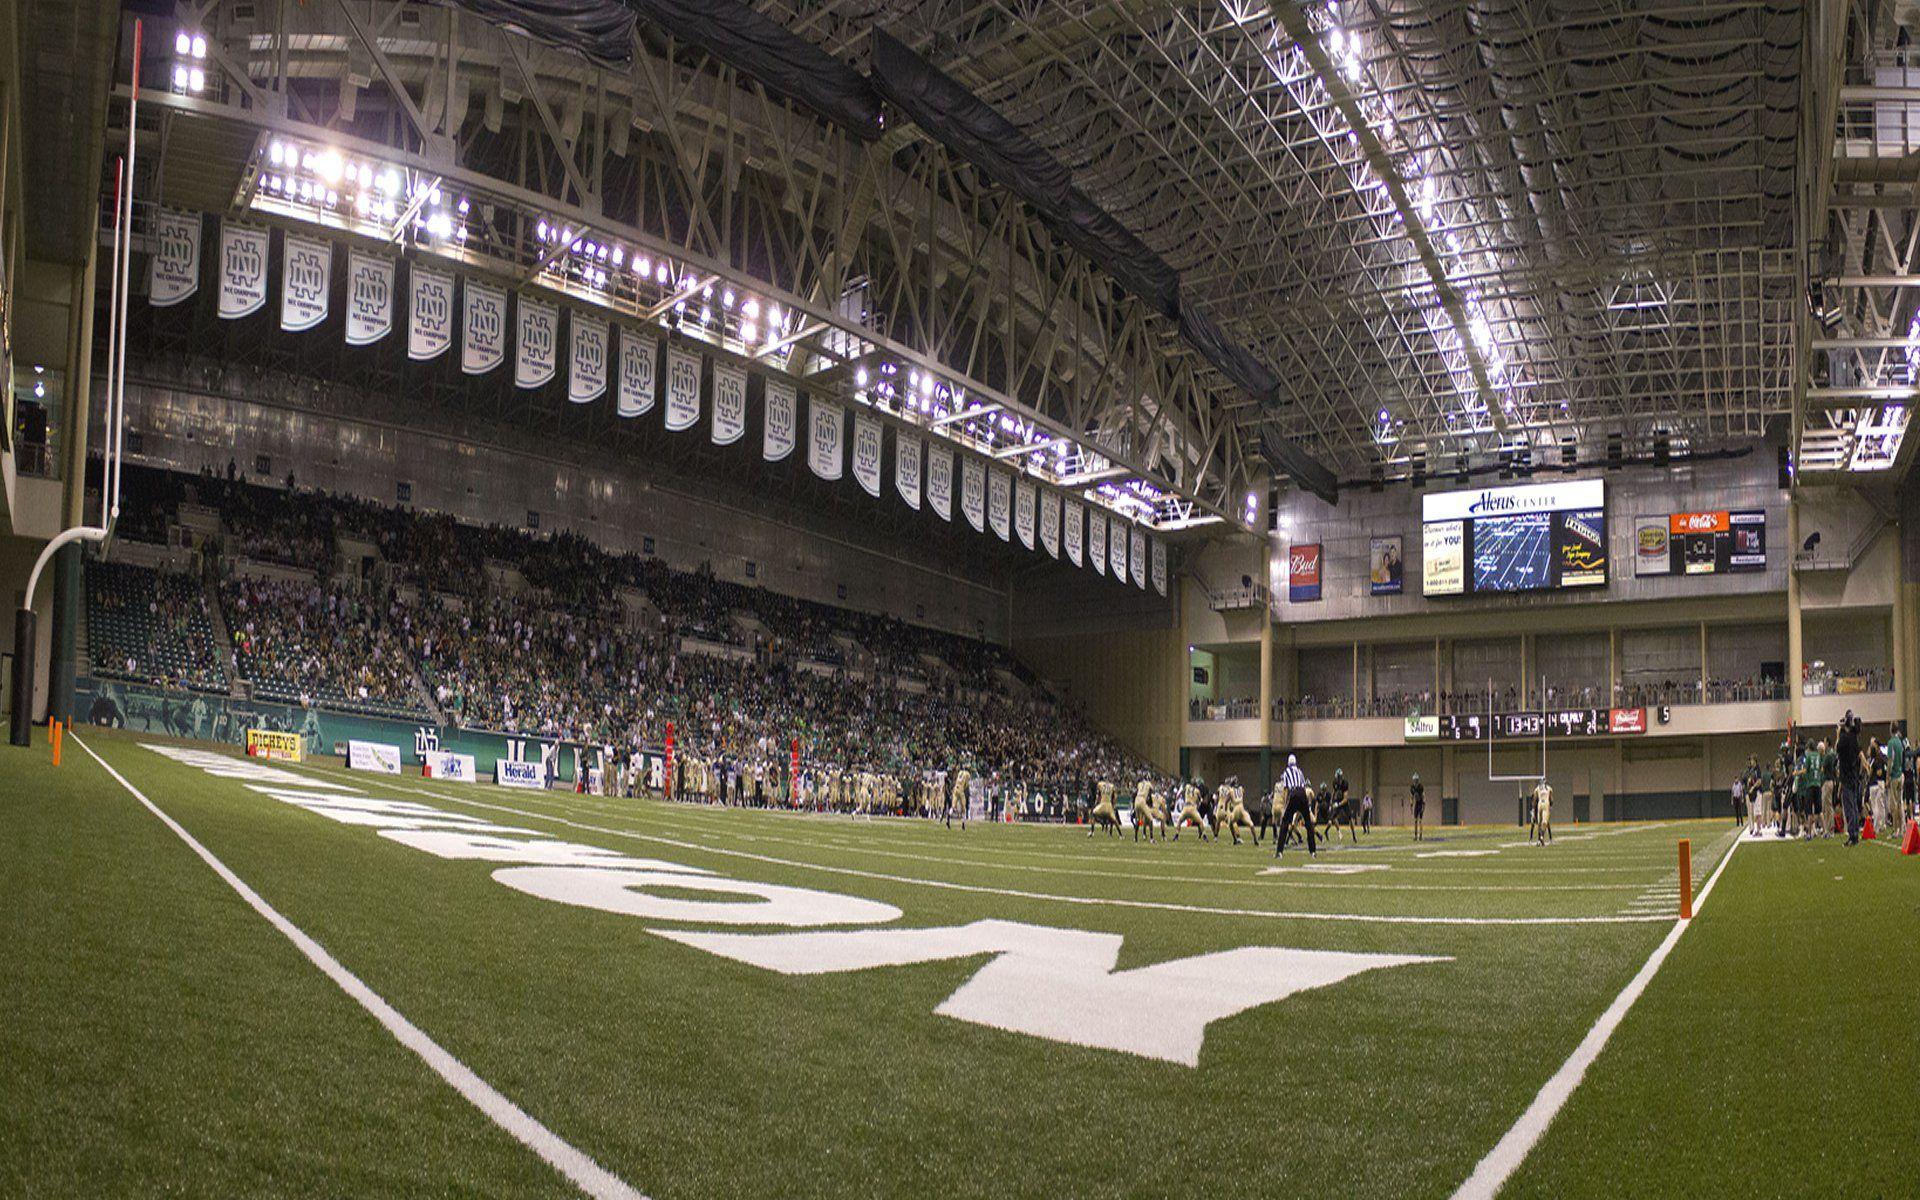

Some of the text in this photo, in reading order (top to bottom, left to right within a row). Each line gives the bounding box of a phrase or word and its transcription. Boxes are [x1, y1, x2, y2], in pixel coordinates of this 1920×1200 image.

[1469, 491, 1556, 513] Alerus CENTER
[1291, 554, 1318, 574] Bud
[1414, 720, 1433, 732] Altru
[1548, 713, 1557, 728] 14
[504, 762, 536, 780] Herald
